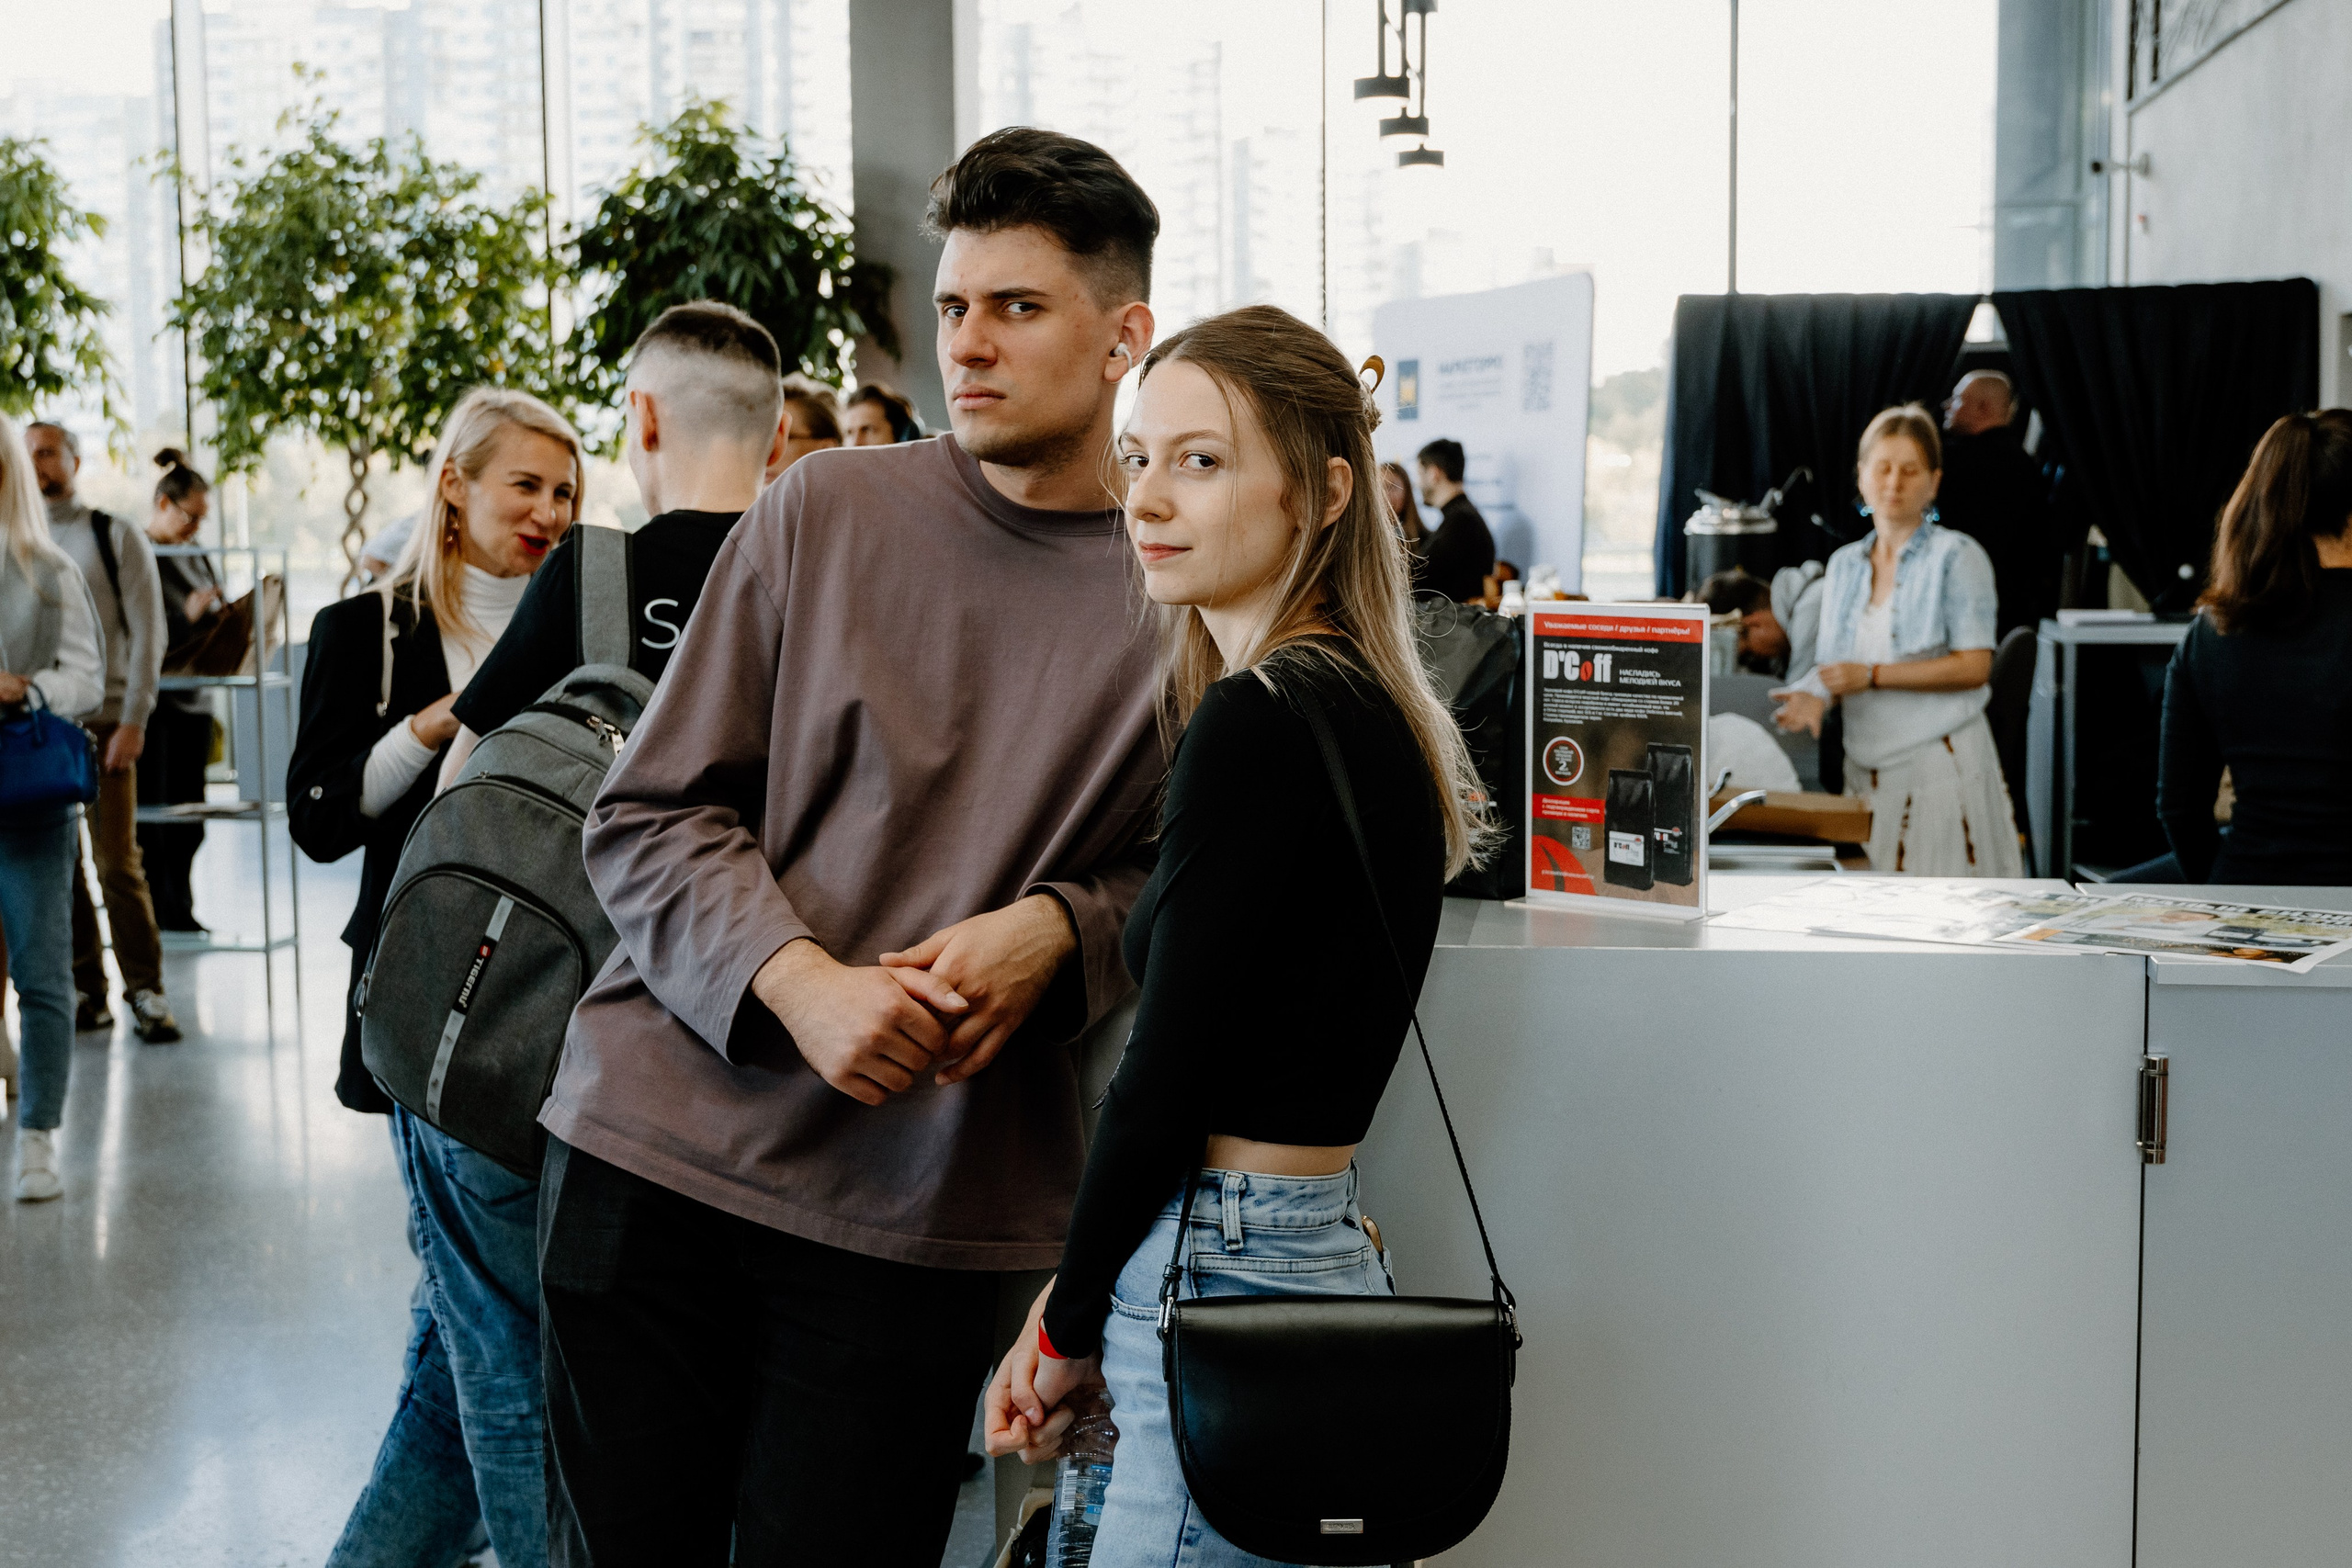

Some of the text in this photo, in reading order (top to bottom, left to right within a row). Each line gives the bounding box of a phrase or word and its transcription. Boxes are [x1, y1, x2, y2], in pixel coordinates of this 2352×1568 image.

[1544, 621, 1587, 631] Уважаемые
[1651, 626, 1690, 636] партнёры!
[1544, 649, 1612, 682] D'Coff
[1619, 669, 1661, 678] НАСЛАДИСЬ
[1619, 677, 1681, 687] МЕЛОДИЕЙ ВКУСА
[1558, 760, 1569, 772] 2
